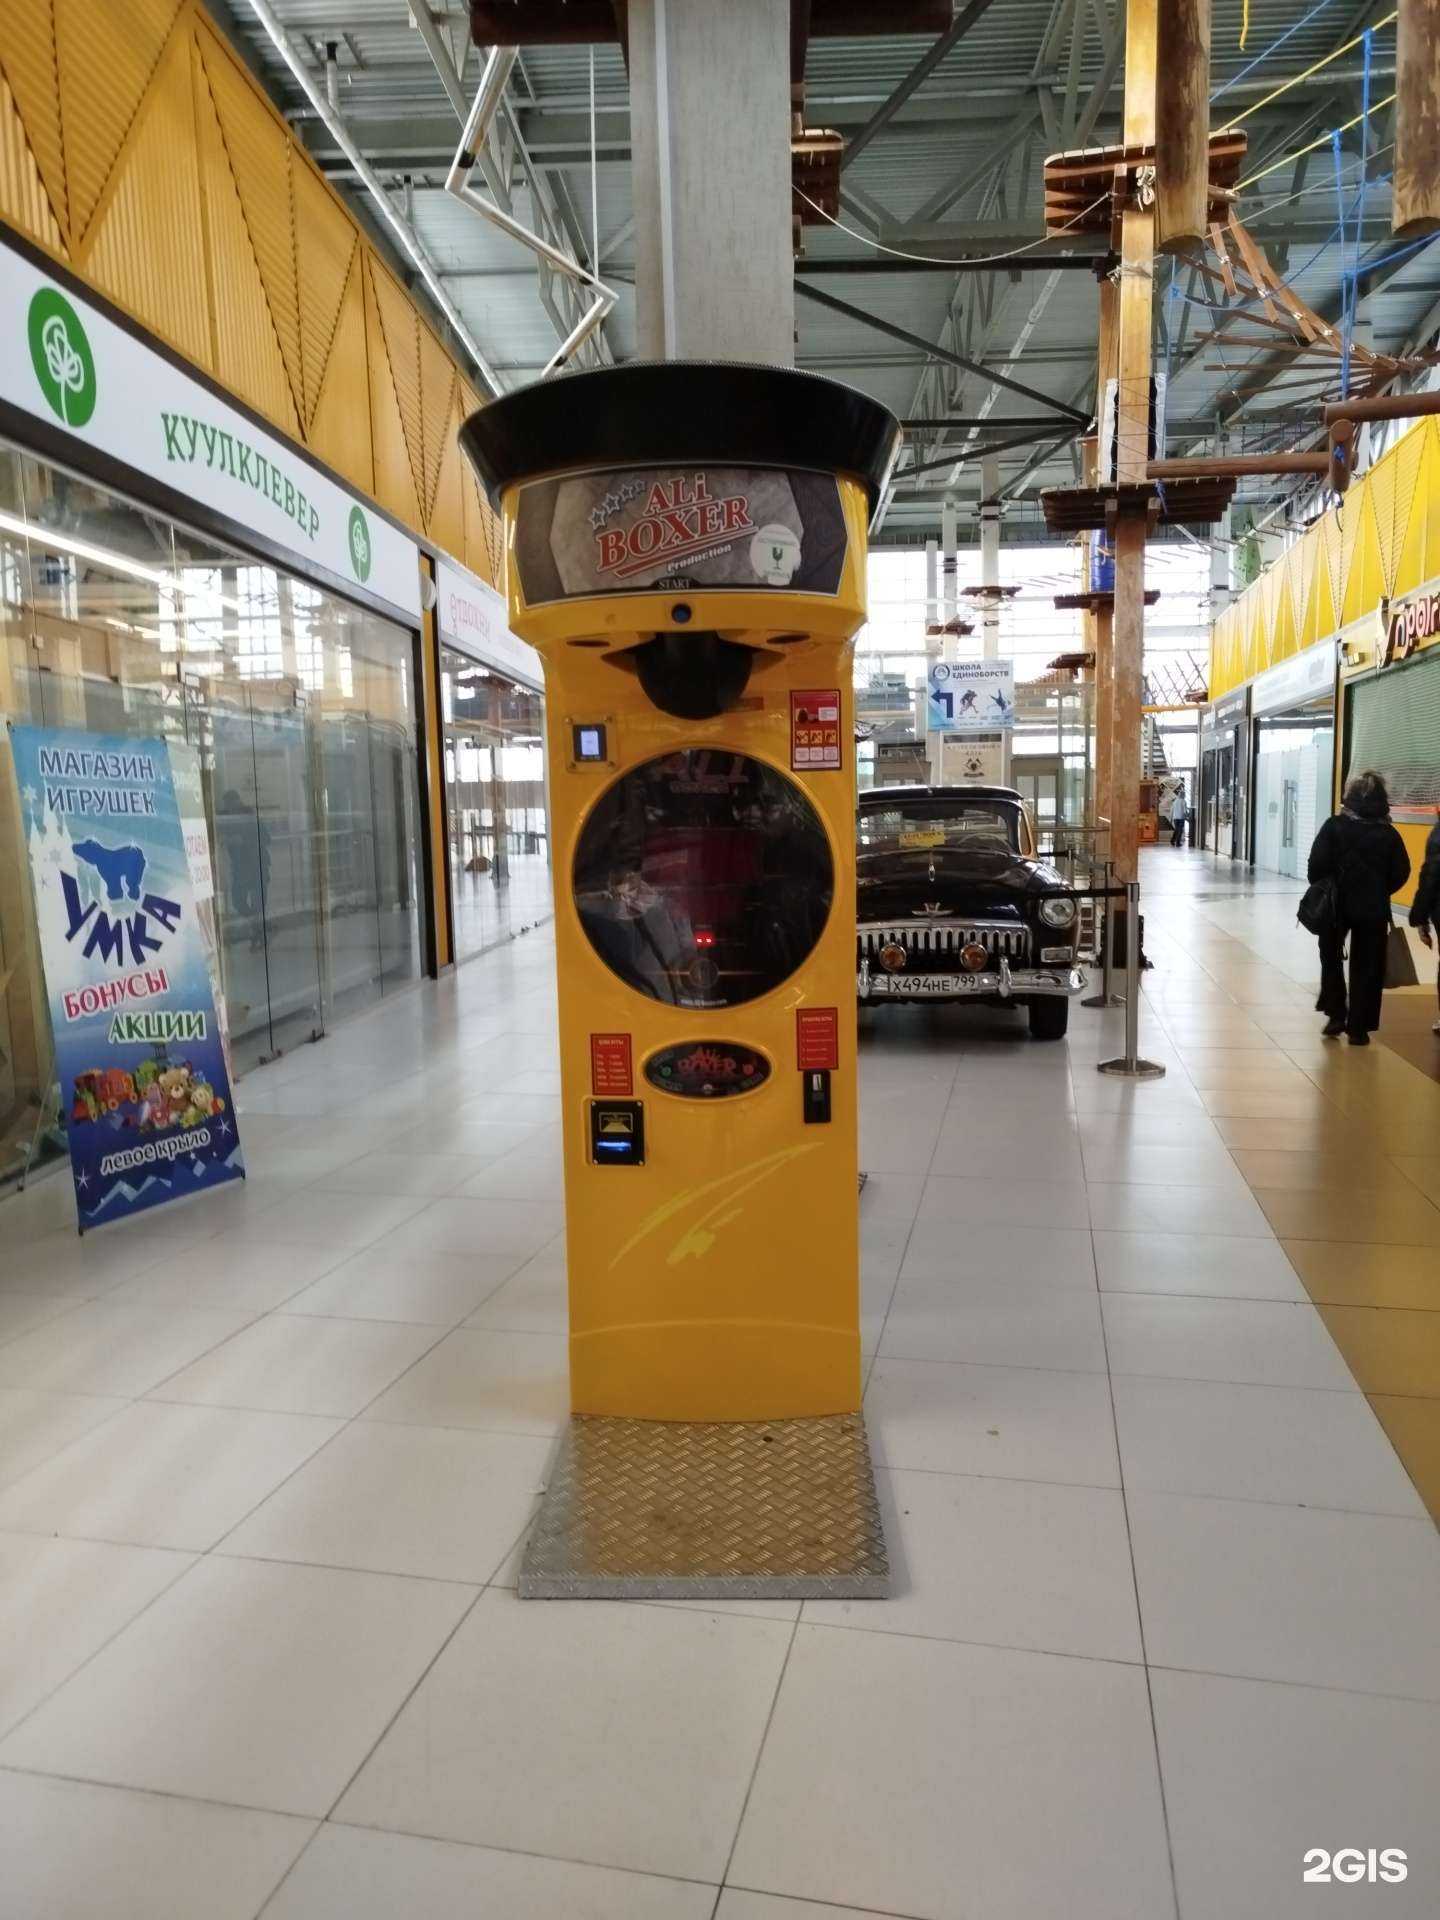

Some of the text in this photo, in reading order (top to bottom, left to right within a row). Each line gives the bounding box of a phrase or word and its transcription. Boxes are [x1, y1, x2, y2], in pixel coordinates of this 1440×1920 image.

[161, 412, 320, 541] КУУЛКЛЕВЕР
[596, 495, 754, 573] BOXER
[952, 671, 1009, 680] ЕДИНОБОРСТВ
[39, 747, 155, 782] МАГАЗИН
[47, 786, 156, 815] ИГРУШЕК
[60, 869, 181, 967] УМКА
[63, 968, 168, 1021] БОНУСЫ
[953, 975, 977, 988] 799
[110, 1011, 206, 1043] АКЦИИ
[101, 1128, 211, 1175] левое крыло
